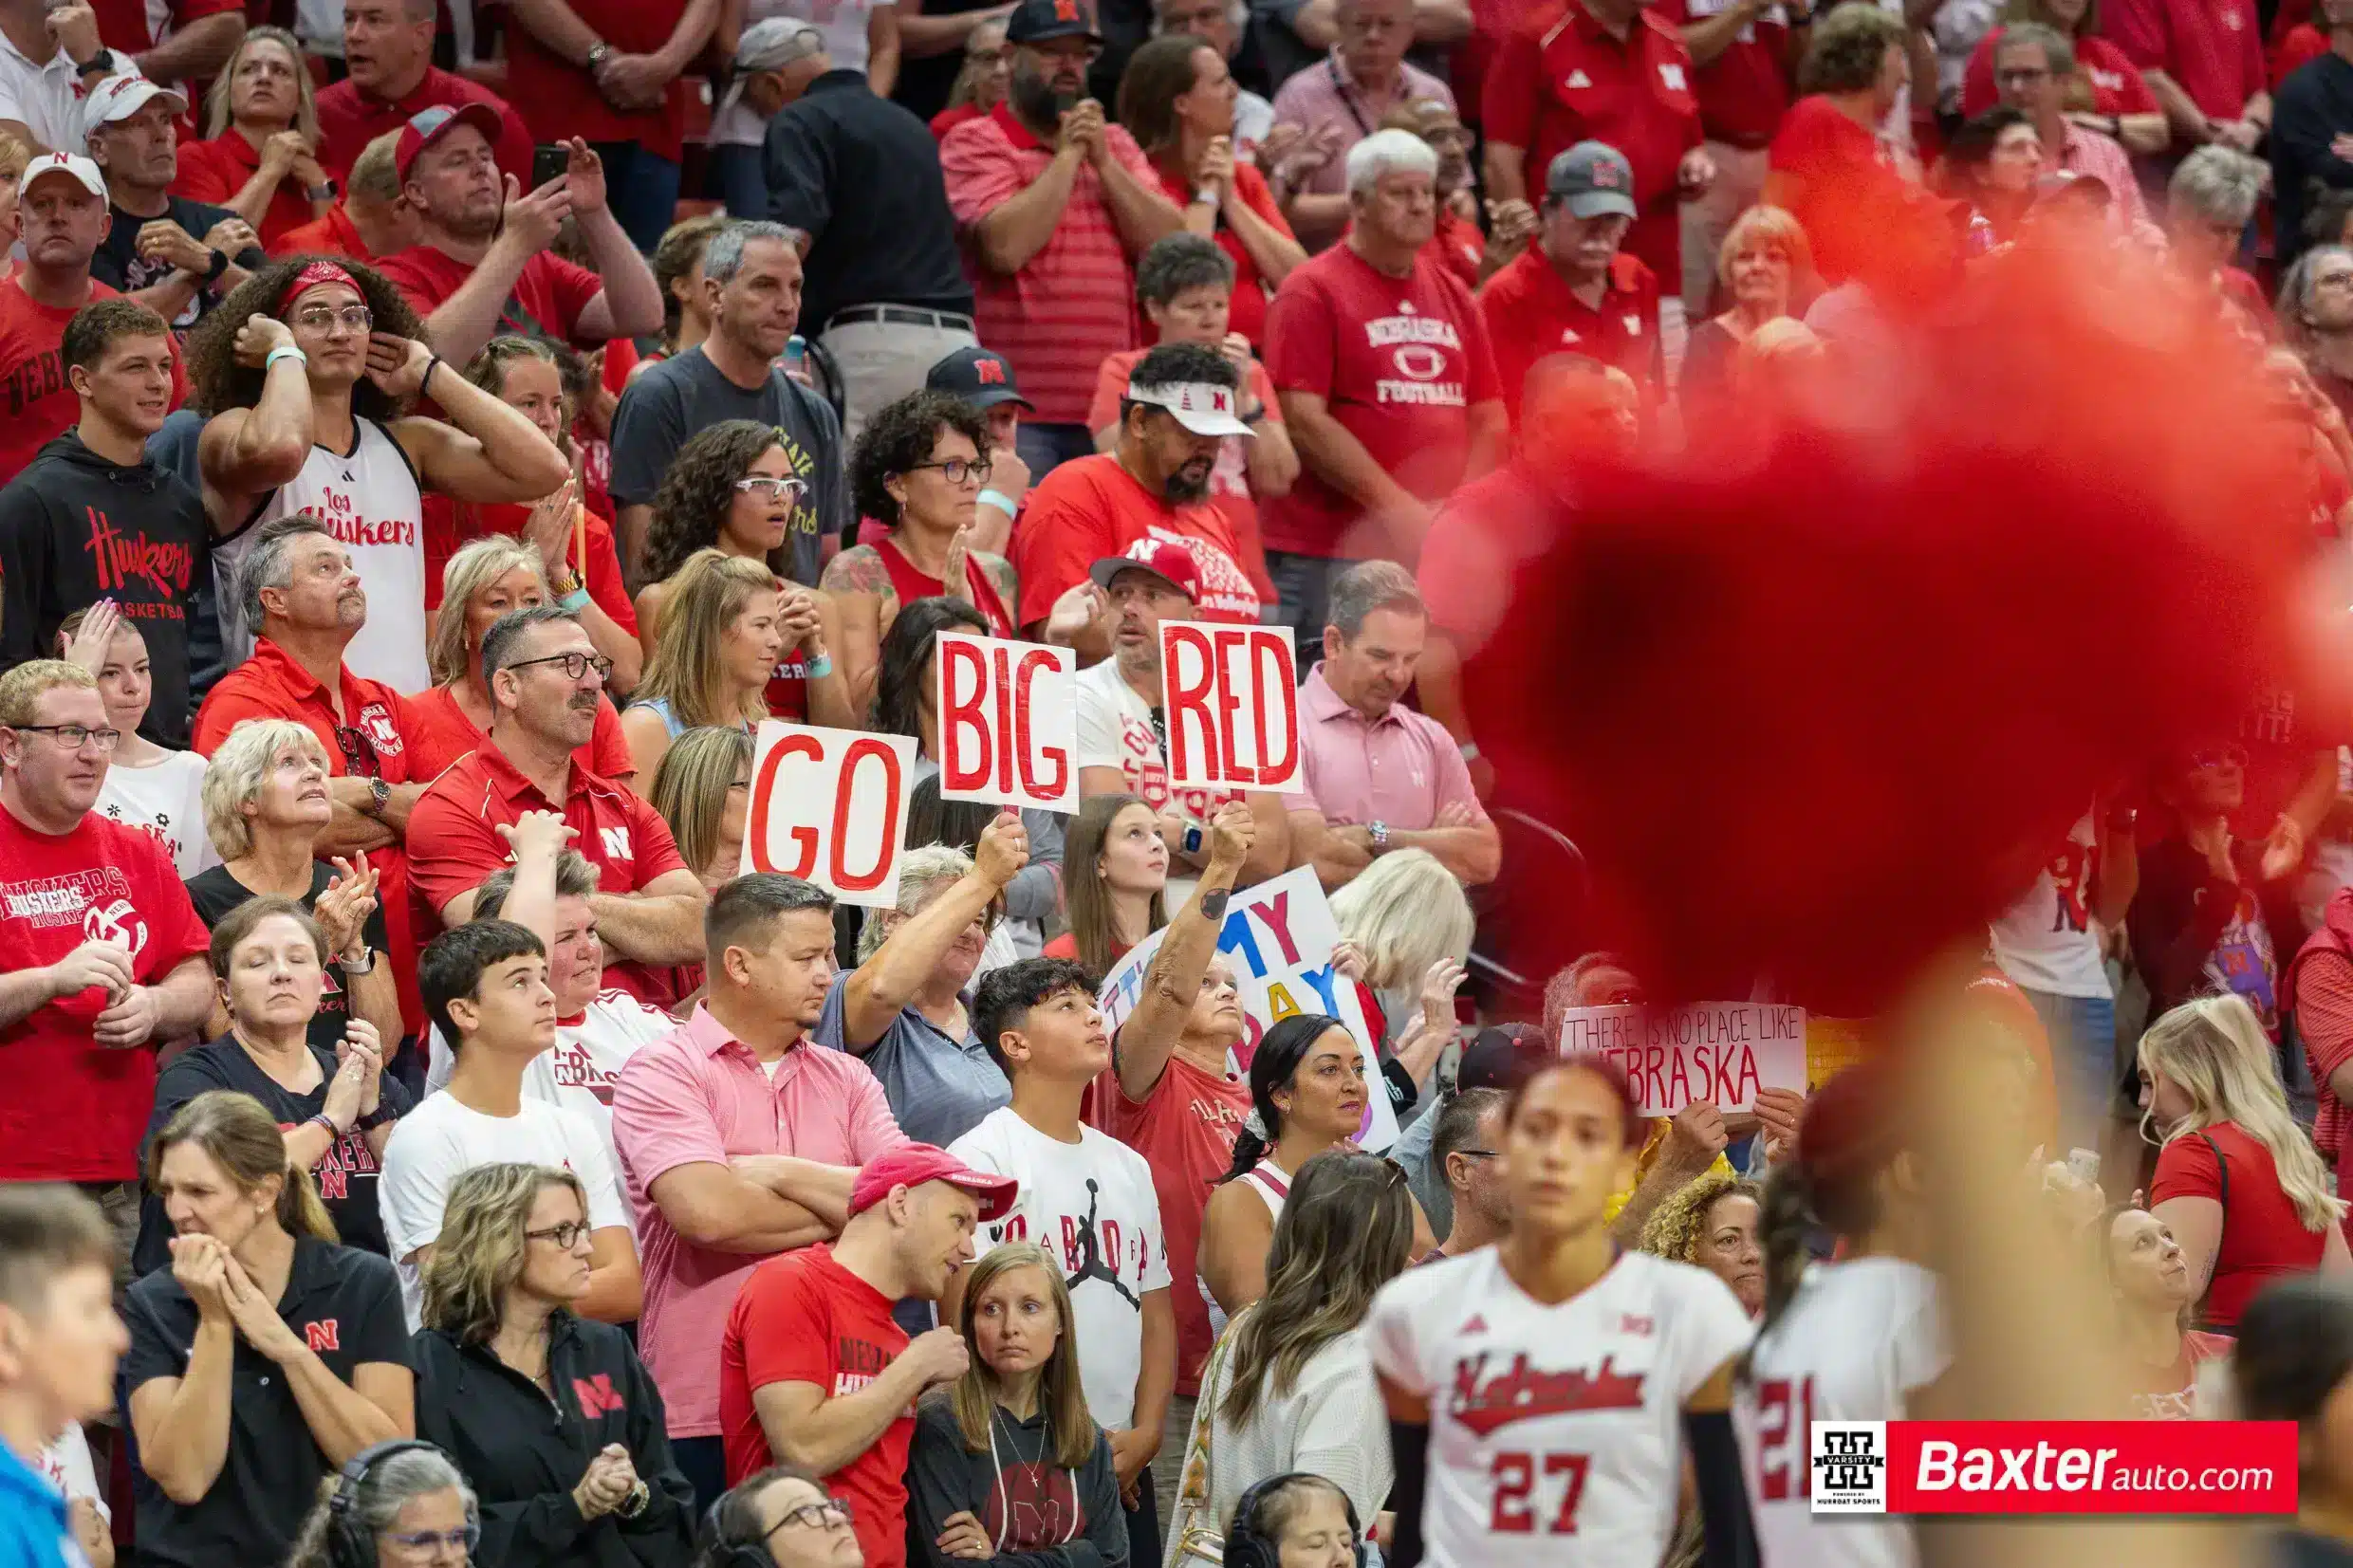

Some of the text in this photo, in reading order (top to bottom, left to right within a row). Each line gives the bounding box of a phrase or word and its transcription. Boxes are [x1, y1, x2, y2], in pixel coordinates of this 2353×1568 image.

[1376, 380, 1466, 407] FOOTBALL
[323, 487, 353, 513] Los
[83, 506, 194, 600] Huskers
[1126, 538, 1161, 563] N
[943, 640, 1068, 801] BIG
[1163, 626, 1298, 785] RED
[370, 718, 397, 740] N
[750, 733, 901, 891] GO
[599, 826, 635, 861] N
[1566, 1006, 1799, 1051] THERE IS NO PLACE LIKE
[1599, 1044, 1763, 1109] BRASKA
[321, 1171, 348, 1199] N
[306, 1319, 340, 1351] N
[572, 1373, 623, 1419] N
[1490, 1451, 1591, 1536] 27
